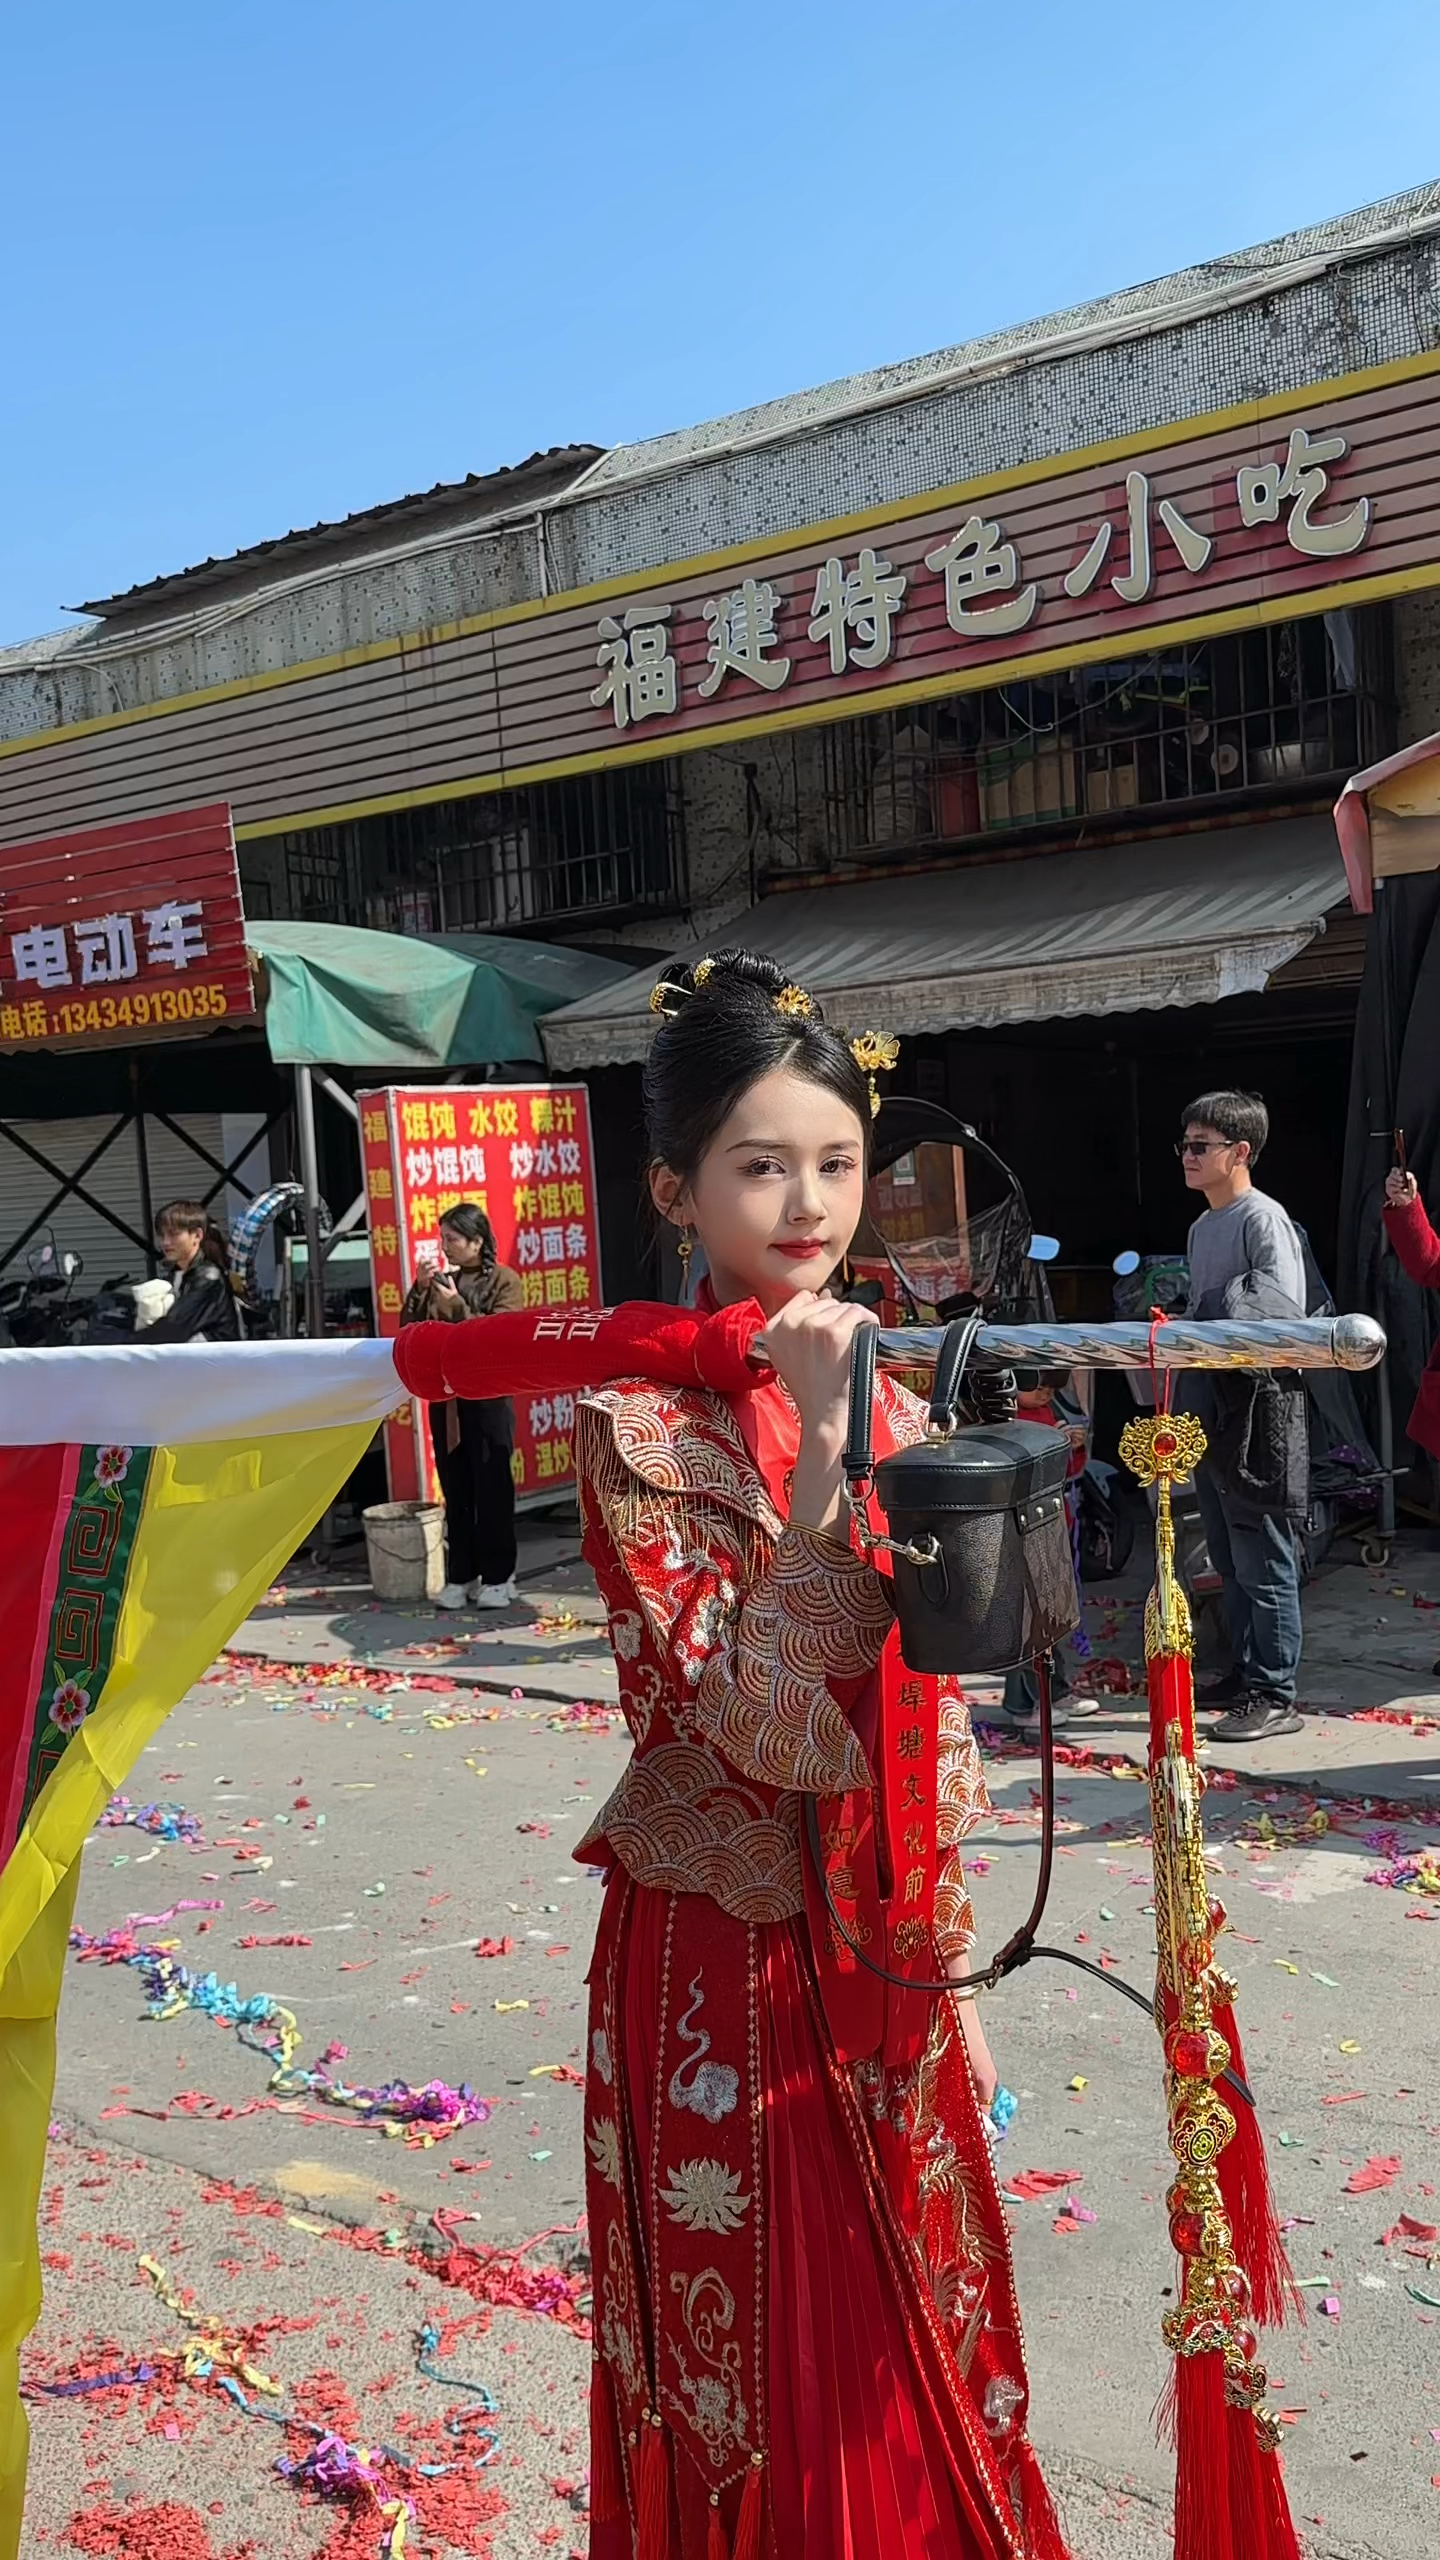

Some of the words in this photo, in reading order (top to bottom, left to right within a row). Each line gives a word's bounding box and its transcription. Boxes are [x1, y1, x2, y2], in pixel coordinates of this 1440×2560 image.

[588, 427, 1375, 730] 福建特色小吃
[11, 900, 208, 989] 电动车
[401, 1100, 457, 1142] 馄饨
[468, 1097, 519, 1140] 水饺
[406, 1143, 486, 1188] 炒馄饨
[509, 1137, 581, 1180] 炒水饺
[513, 1180, 585, 1222] 炸馄饨
[517, 1222, 588, 1266] 炒面条
[521, 1264, 590, 1308] 捞面条
[530, 1385, 595, 1437] 炒粉
[818, 1791, 861, 1899] 如意
